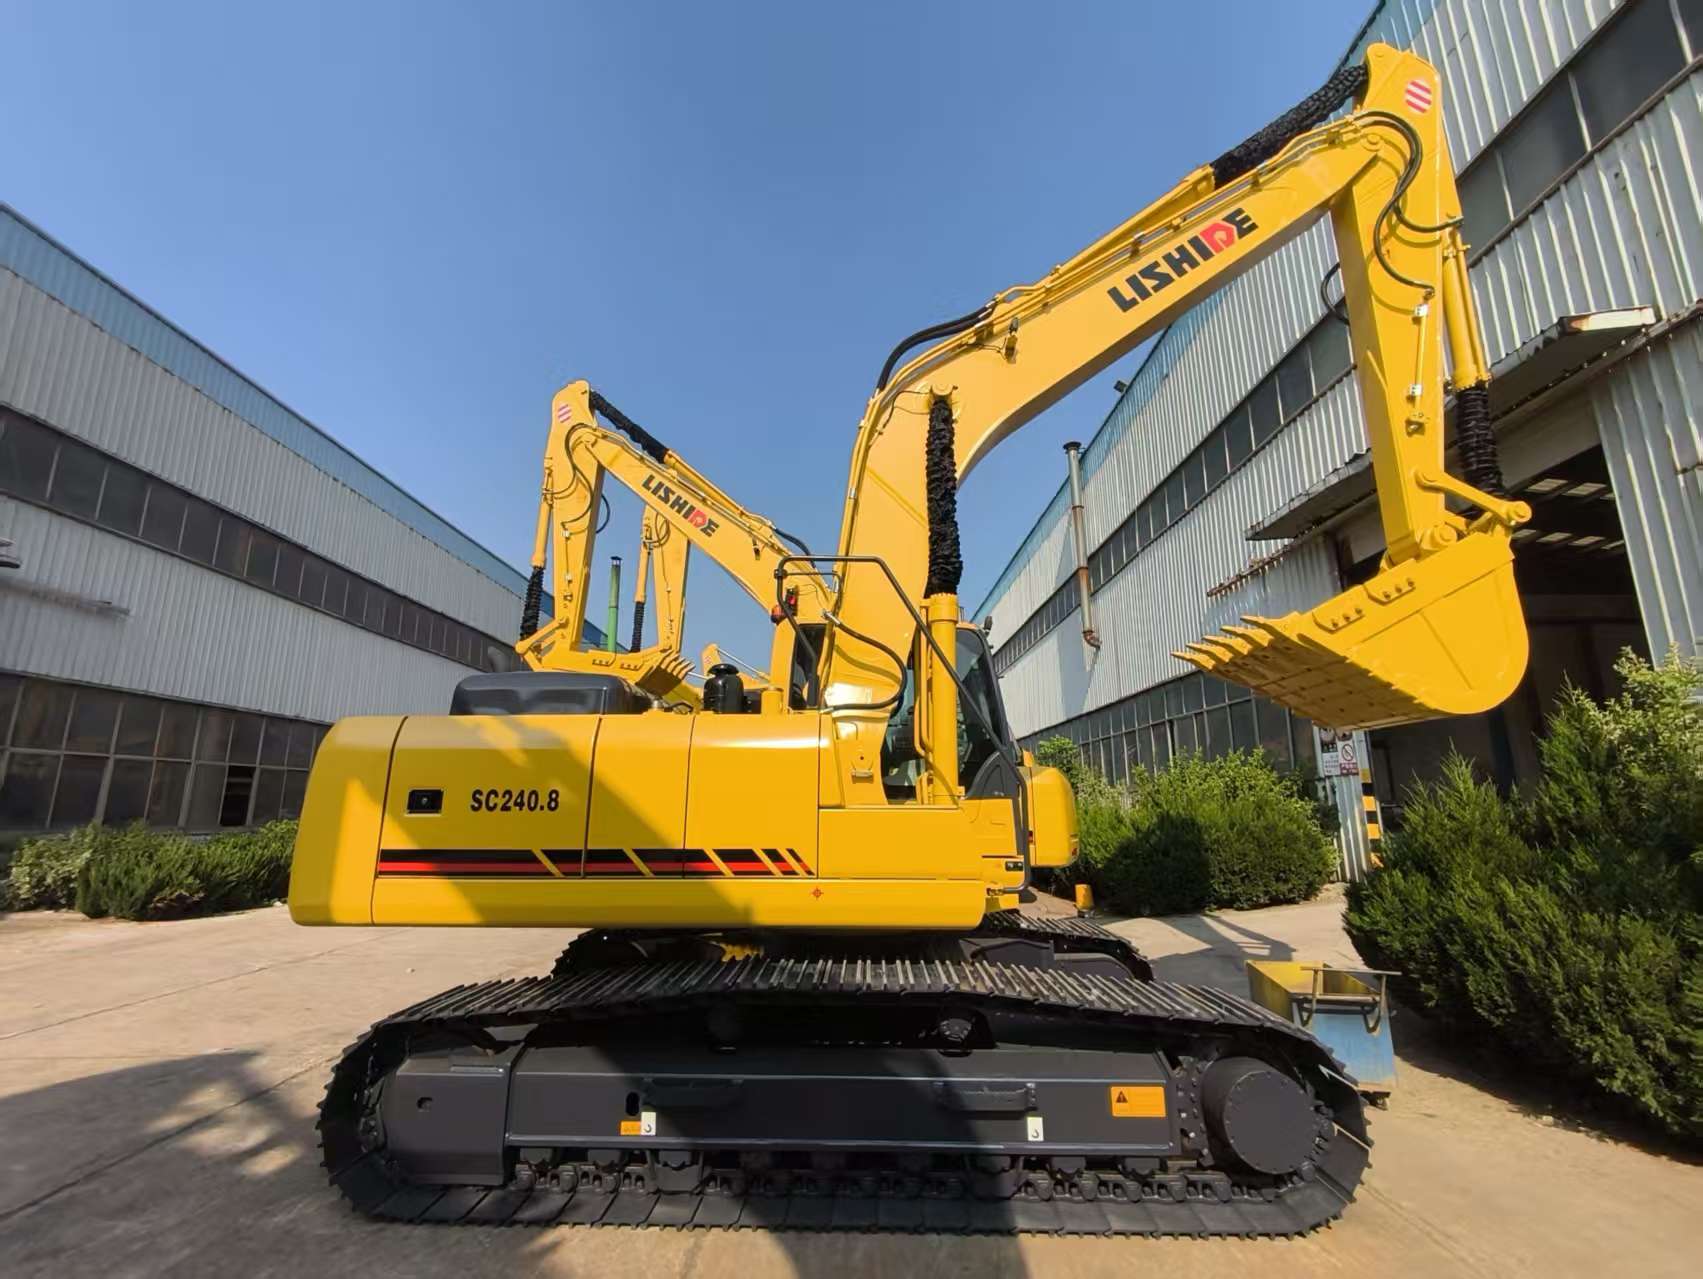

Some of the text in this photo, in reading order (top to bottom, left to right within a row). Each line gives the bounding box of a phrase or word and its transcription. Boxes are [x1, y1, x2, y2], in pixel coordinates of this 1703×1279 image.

[1107, 208, 1259, 313] LISHIDE
[642, 474, 720, 537] LISHIDE
[470, 789, 560, 812] SC240.8
